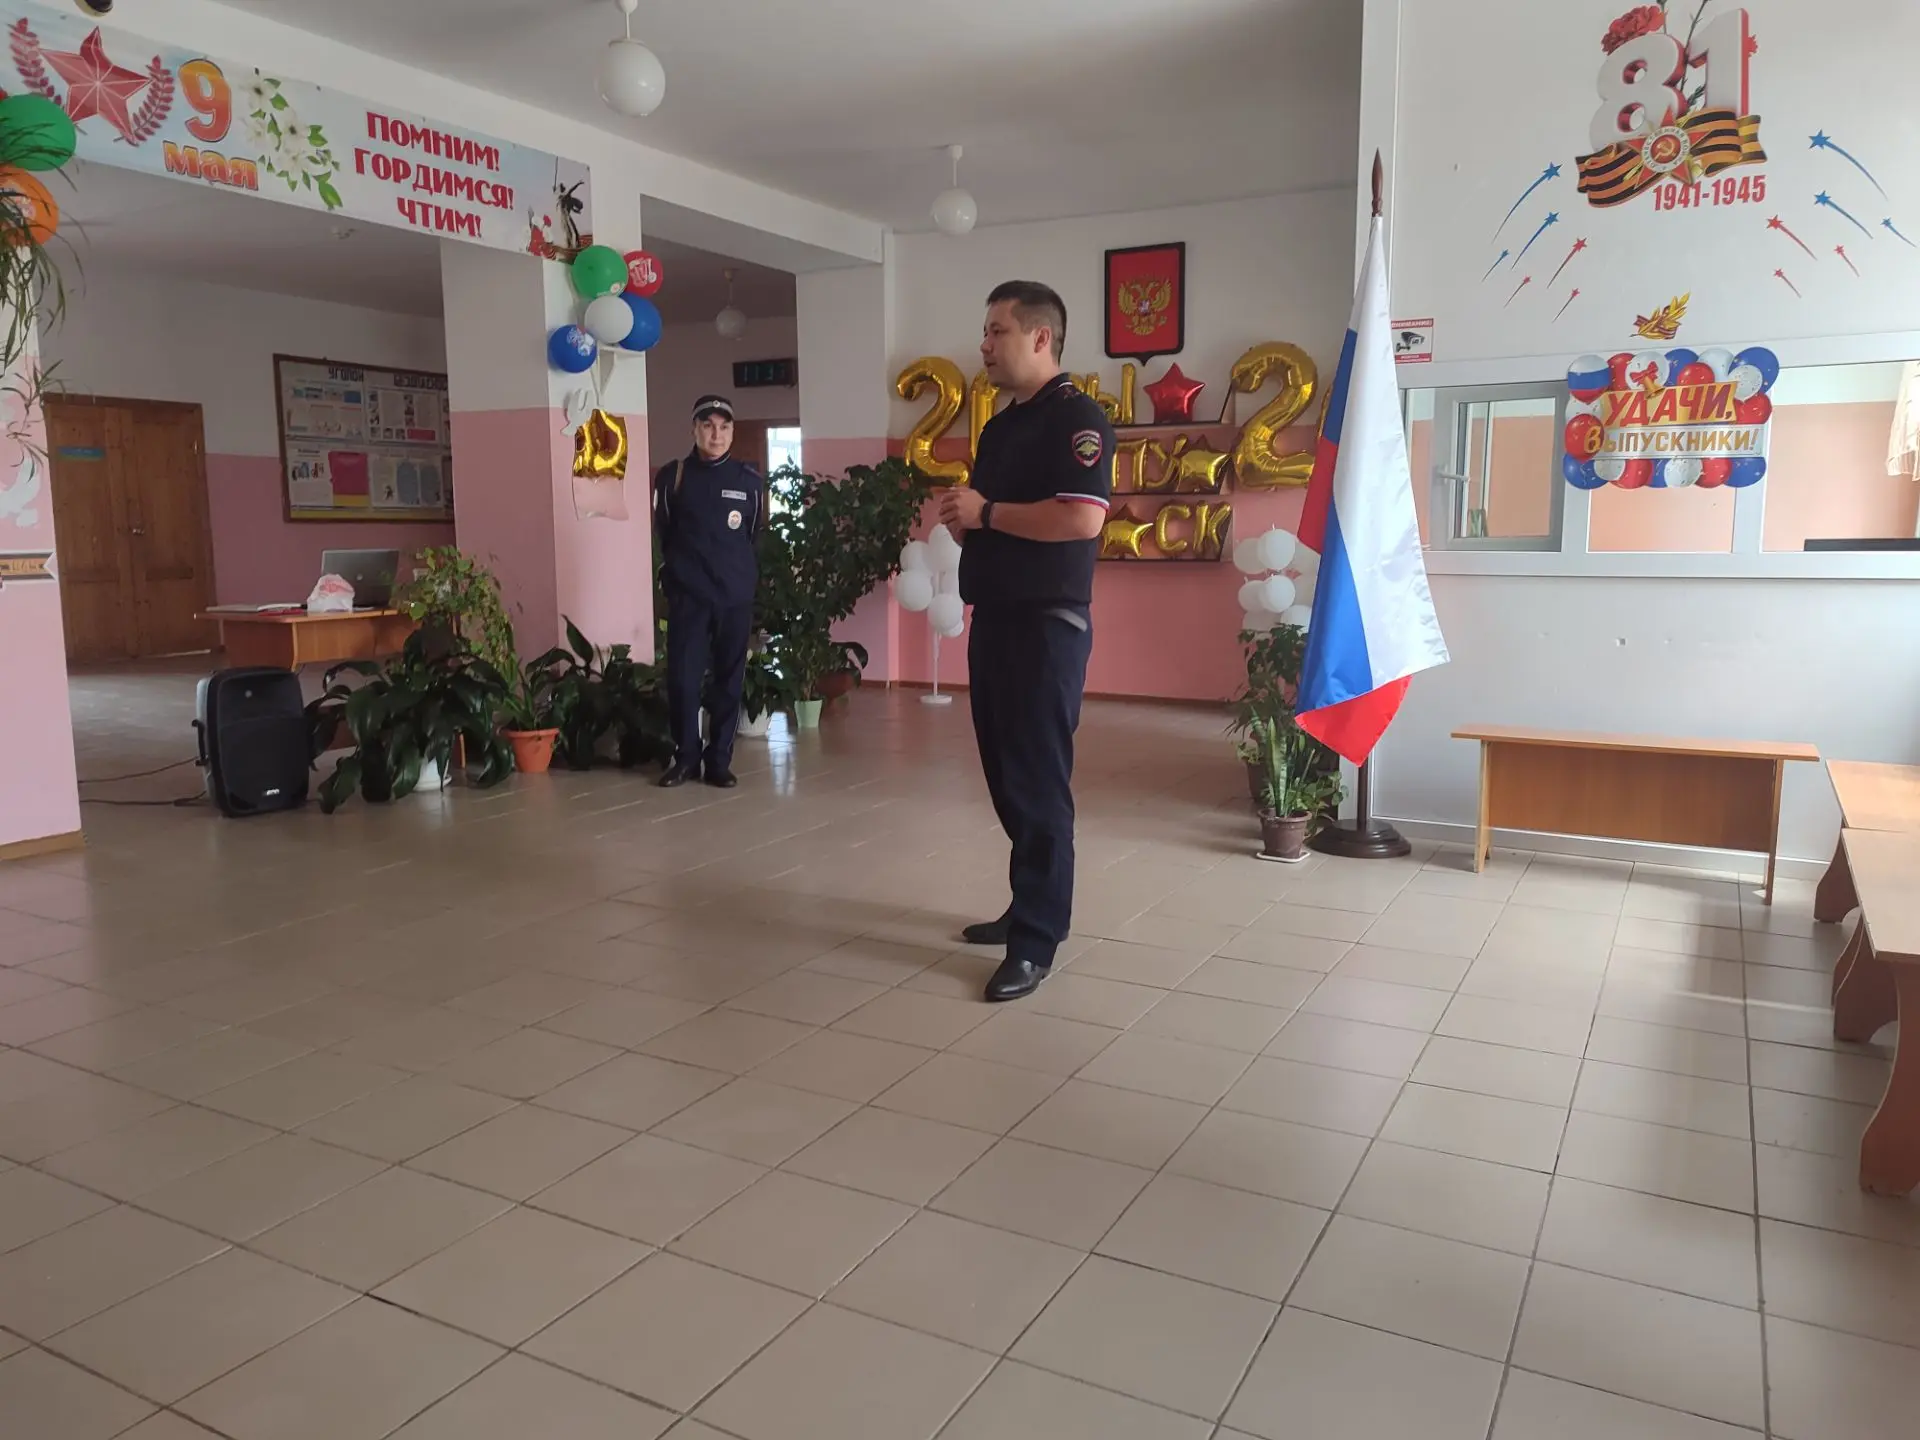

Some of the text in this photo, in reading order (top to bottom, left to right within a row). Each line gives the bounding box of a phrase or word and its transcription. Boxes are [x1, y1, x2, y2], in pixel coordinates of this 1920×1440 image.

[178, 58, 232, 143] 9
[1589, 8, 1750, 155] 81
[163, 140, 259, 191] мая
[366, 111, 500, 172] ПОМНИМ!
[354, 147, 514, 211] ГОРДИМСЯ!
[1652, 174, 1766, 211] 1941-1945
[397, 196, 482, 238] ЧТИМ!
[1604, 383, 1733, 427] УДАЧИ,
